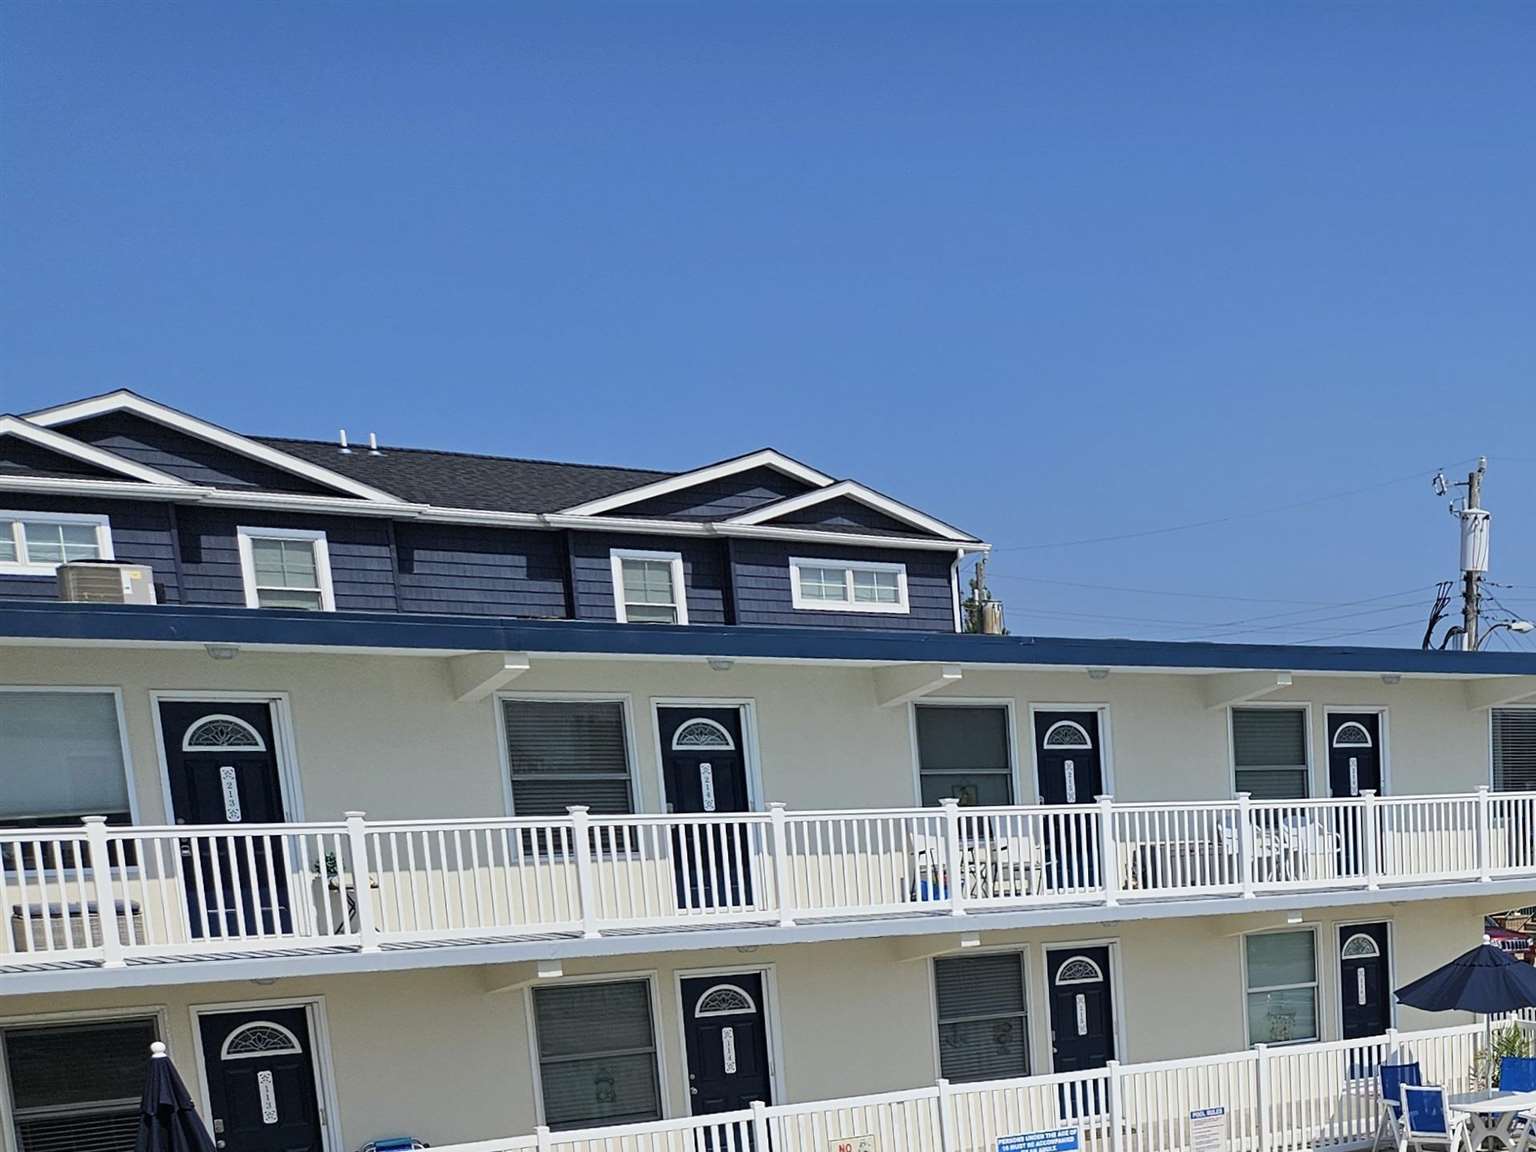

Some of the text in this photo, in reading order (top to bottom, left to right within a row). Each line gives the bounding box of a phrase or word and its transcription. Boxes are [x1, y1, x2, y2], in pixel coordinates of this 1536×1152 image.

[226, 781, 236, 807] 213
[264, 1084, 272, 1109] 113
[998, 1136, 1025, 1145] PERSONS
[1025, 1133, 1045, 1141] UNDER
[1010, 1143, 1026, 1151] MUST
[1035, 1136, 1075, 1147] ACCOMPANIED
